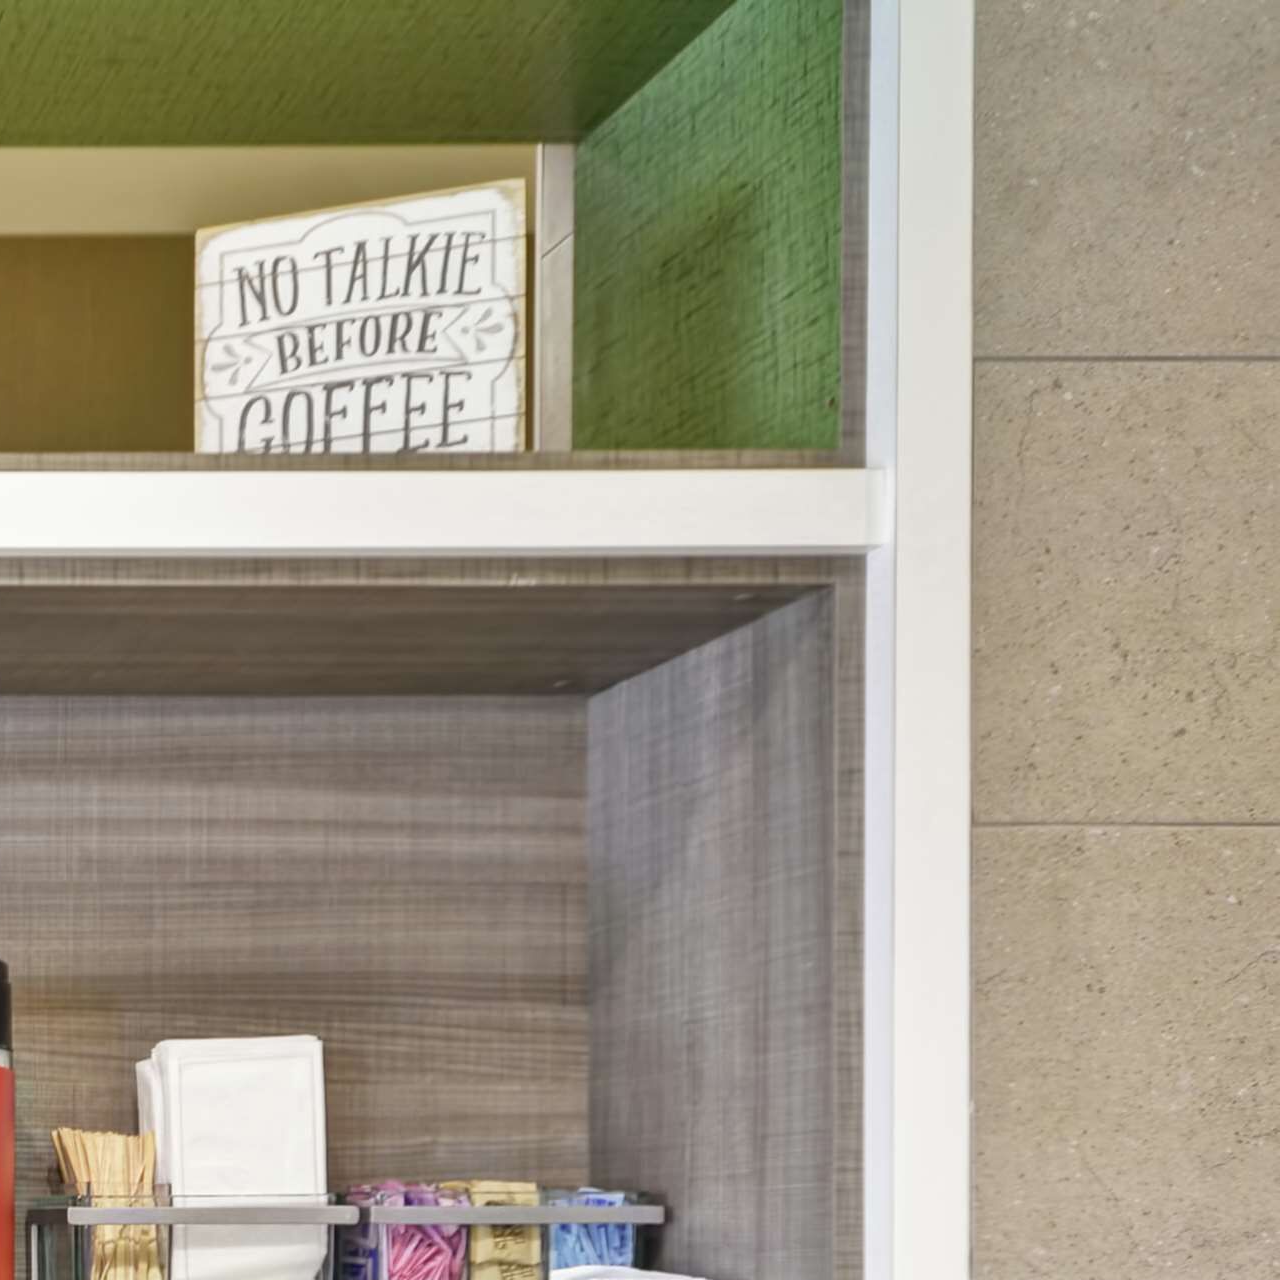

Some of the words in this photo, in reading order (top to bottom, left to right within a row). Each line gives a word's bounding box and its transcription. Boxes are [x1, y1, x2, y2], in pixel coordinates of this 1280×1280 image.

[234, 255, 299, 327] NO
[314, 231, 486, 307] TALKIE
[275, 310, 443, 375] BEFORE
[238, 370, 473, 455] COFFEE
